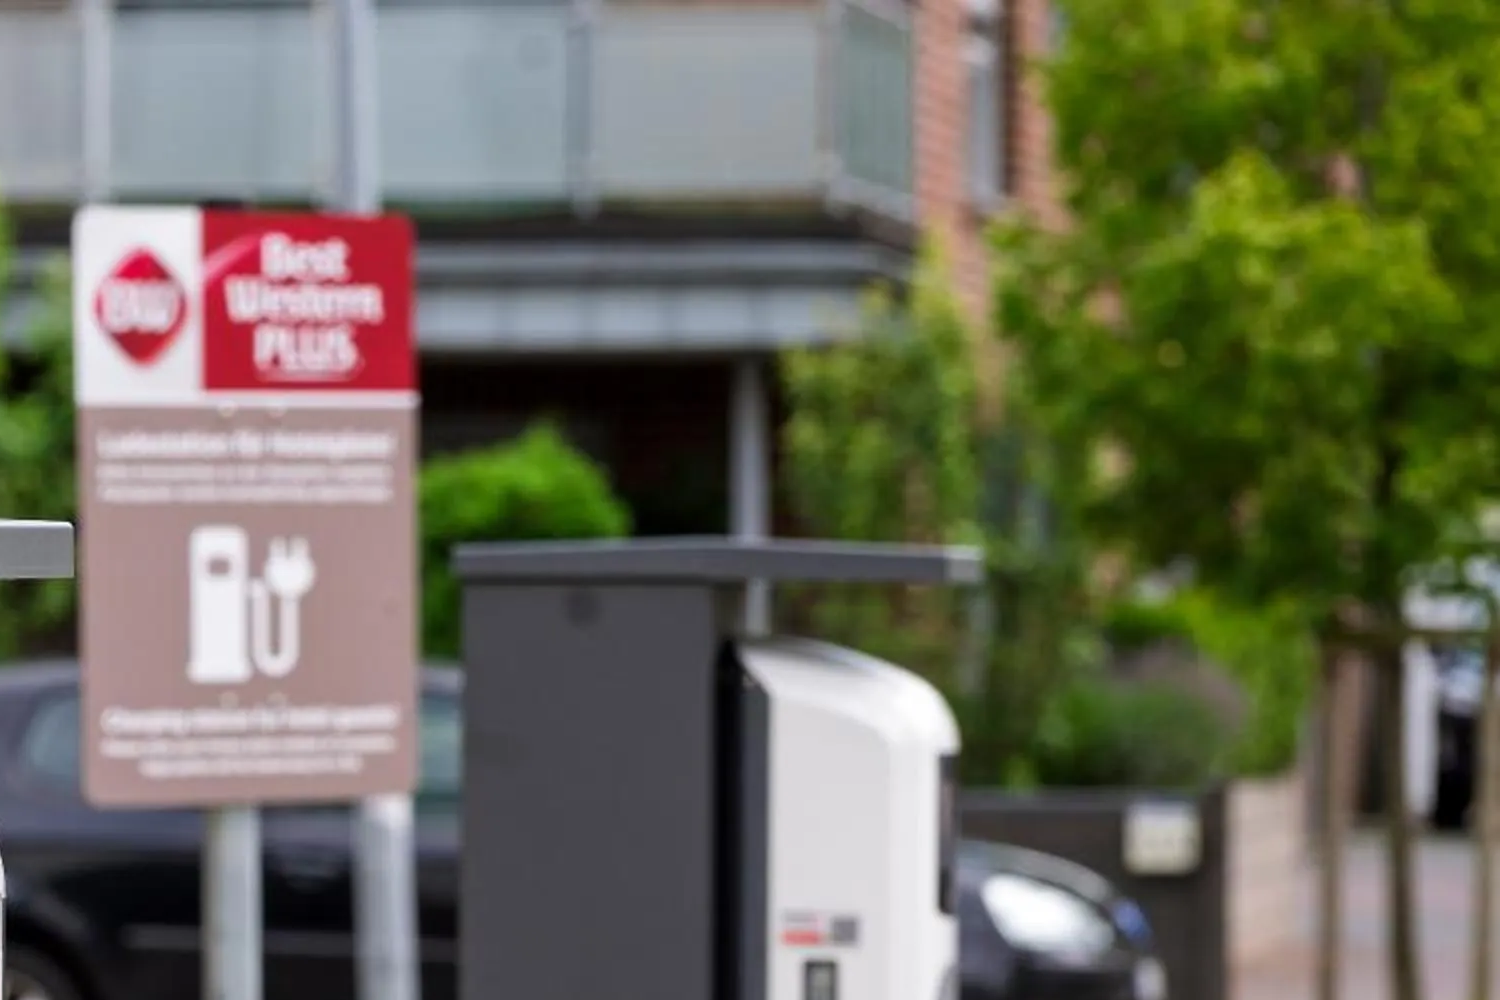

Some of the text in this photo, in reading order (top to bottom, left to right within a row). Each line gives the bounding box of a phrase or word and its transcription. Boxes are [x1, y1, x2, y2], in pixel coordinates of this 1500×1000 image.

[260, 233, 349, 279] Best
[225, 276, 385, 324] Western
[254, 325, 358, 373] PLUS
